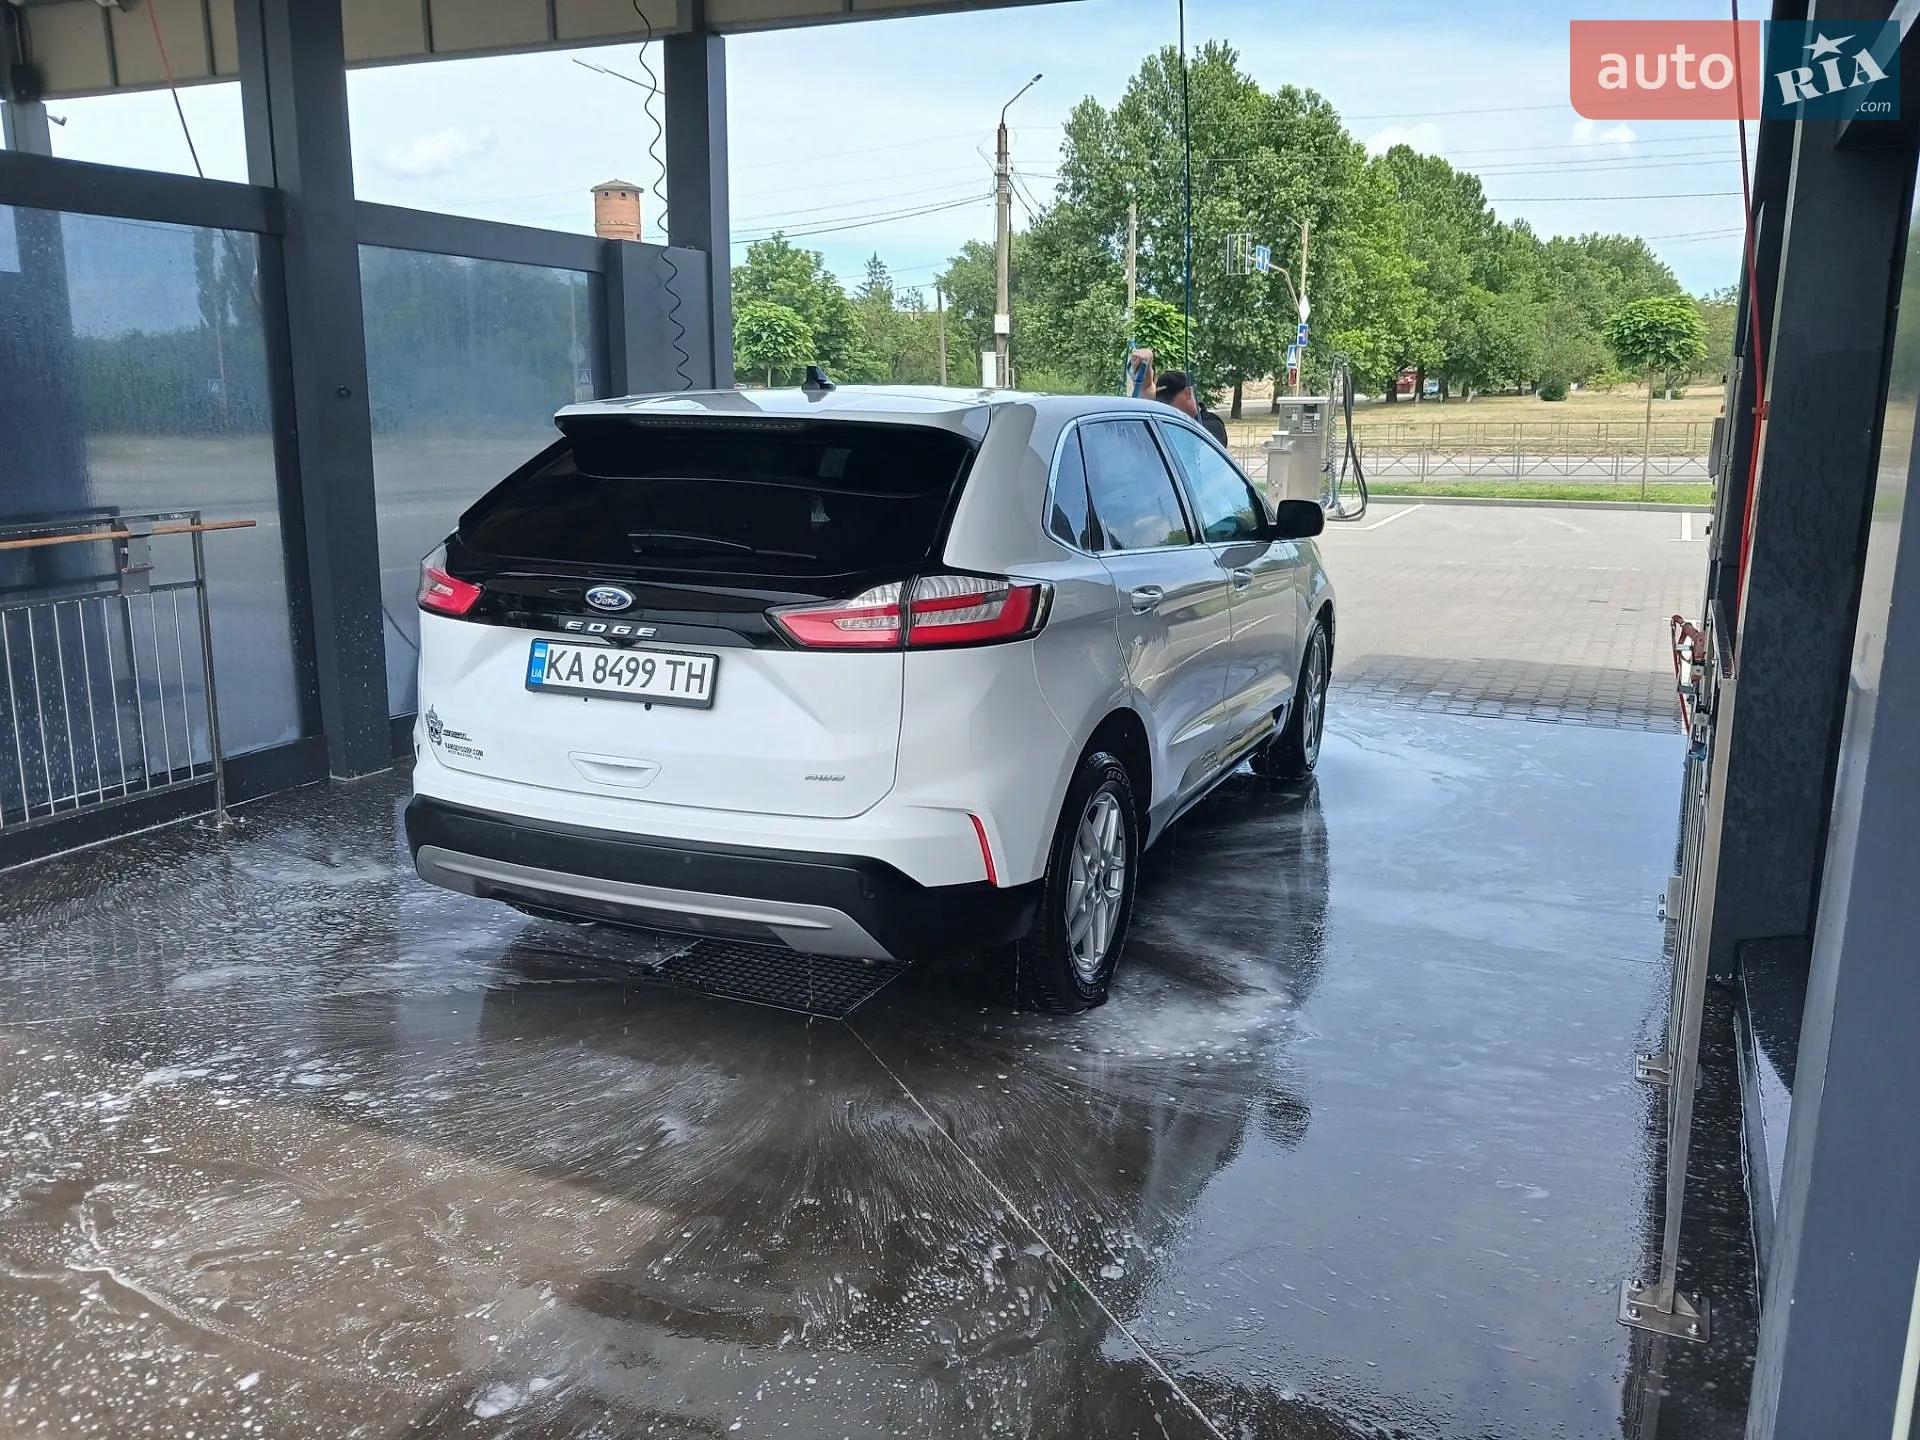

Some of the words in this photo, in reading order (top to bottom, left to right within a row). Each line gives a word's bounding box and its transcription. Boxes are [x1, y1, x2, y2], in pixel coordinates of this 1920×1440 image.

[594, 590, 621, 606] Ford
[565, 621, 658, 637] EDGE
[531, 667, 543, 679] UA
[546, 648, 584, 683] KA
[593, 653, 657, 689] 8499
[665, 659, 707, 694] TH
